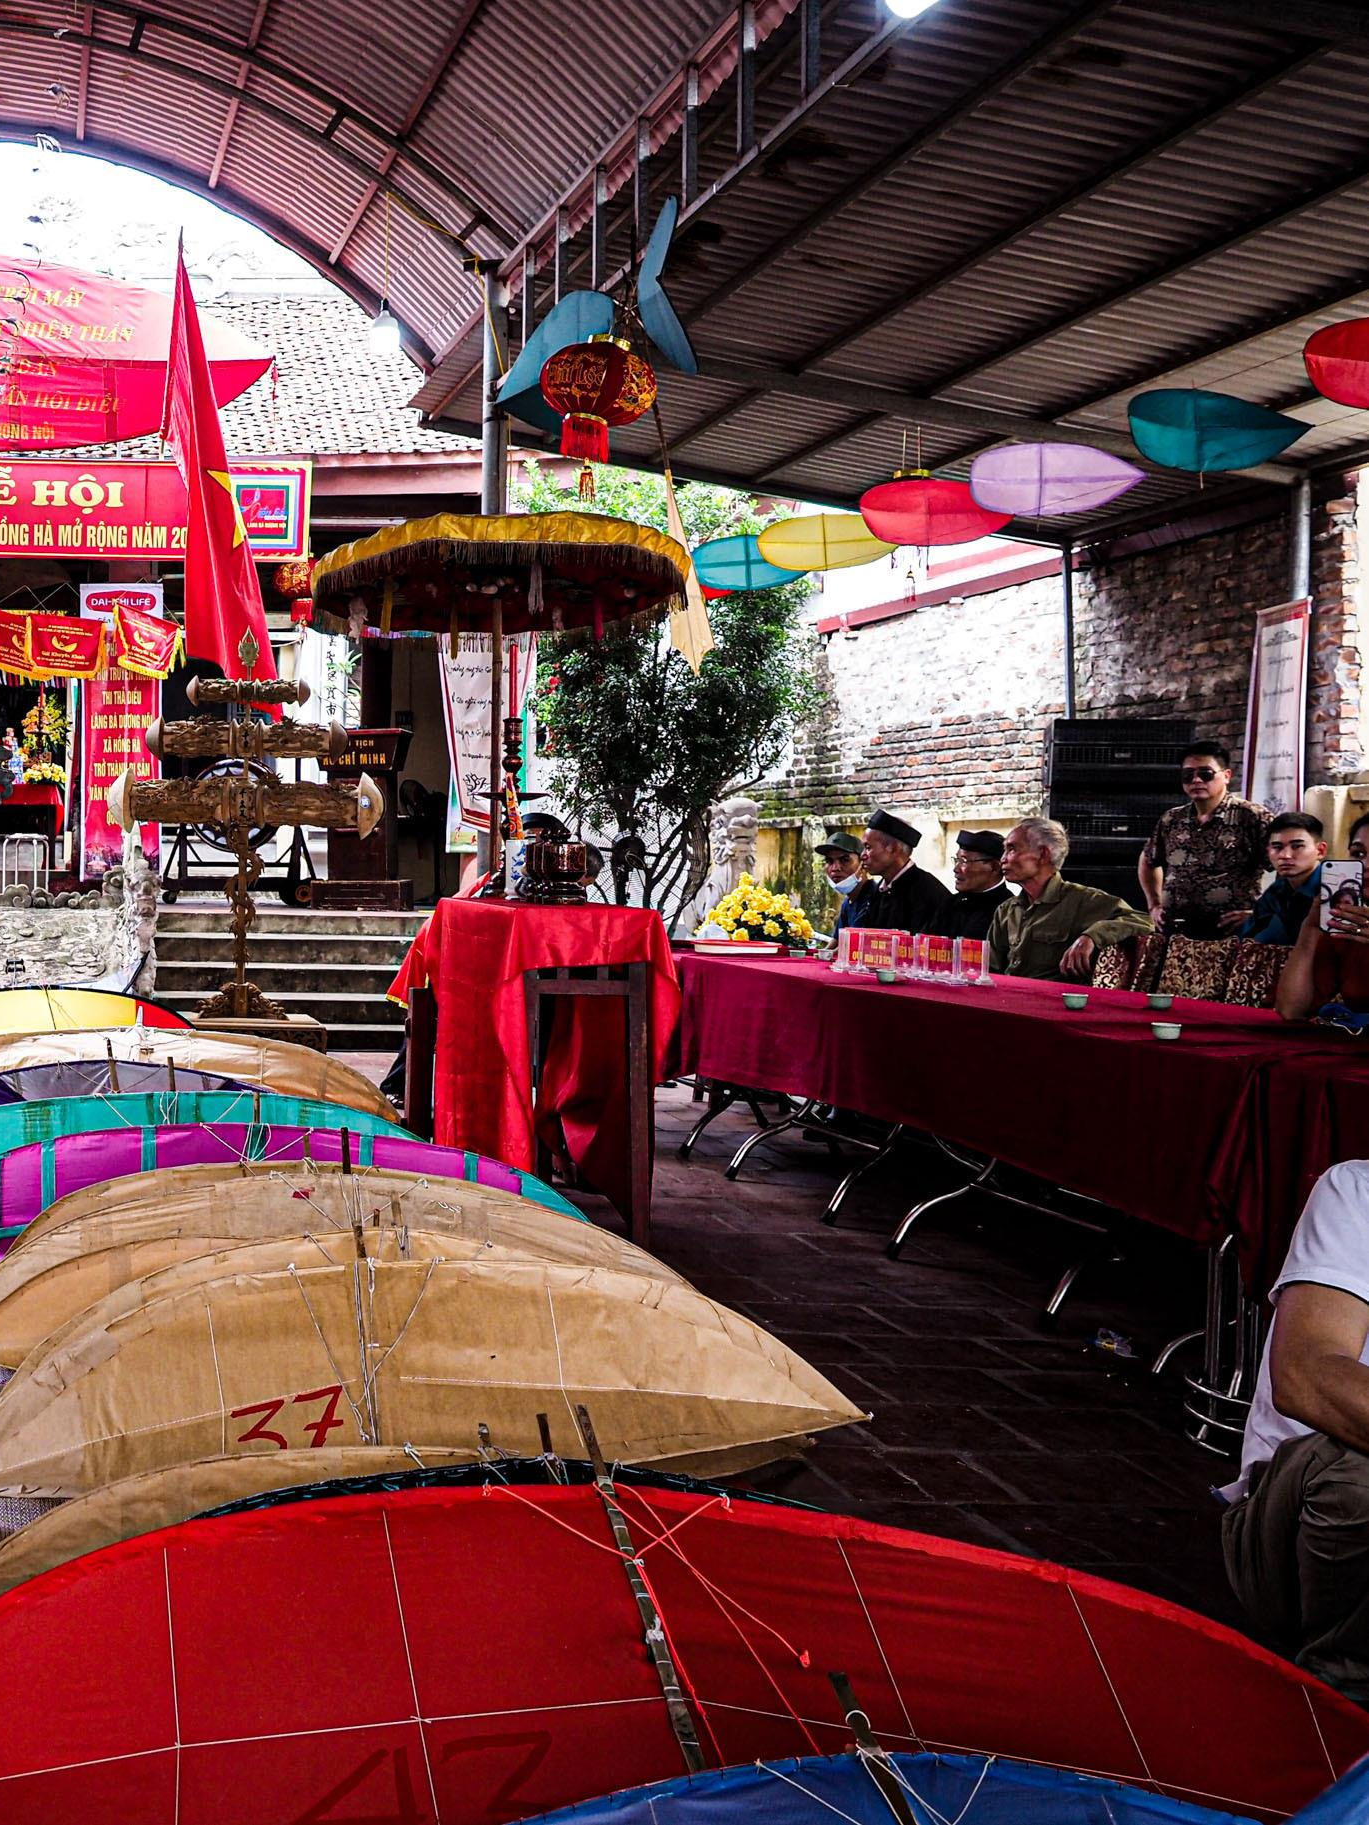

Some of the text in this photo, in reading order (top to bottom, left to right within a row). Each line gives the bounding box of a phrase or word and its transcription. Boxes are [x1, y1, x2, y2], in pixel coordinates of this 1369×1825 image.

[31, 473, 125, 515] HỘI
[33, 518, 54, 547] HÀ
[58, 518, 83, 549] MỞ
[86, 520, 128, 552] RỘNG
[131, 521, 167, 549] NĂM
[131, 598, 151, 606] LIFE
[359, 752, 387, 766] MINH
[231, 1384, 345, 1450] 37
